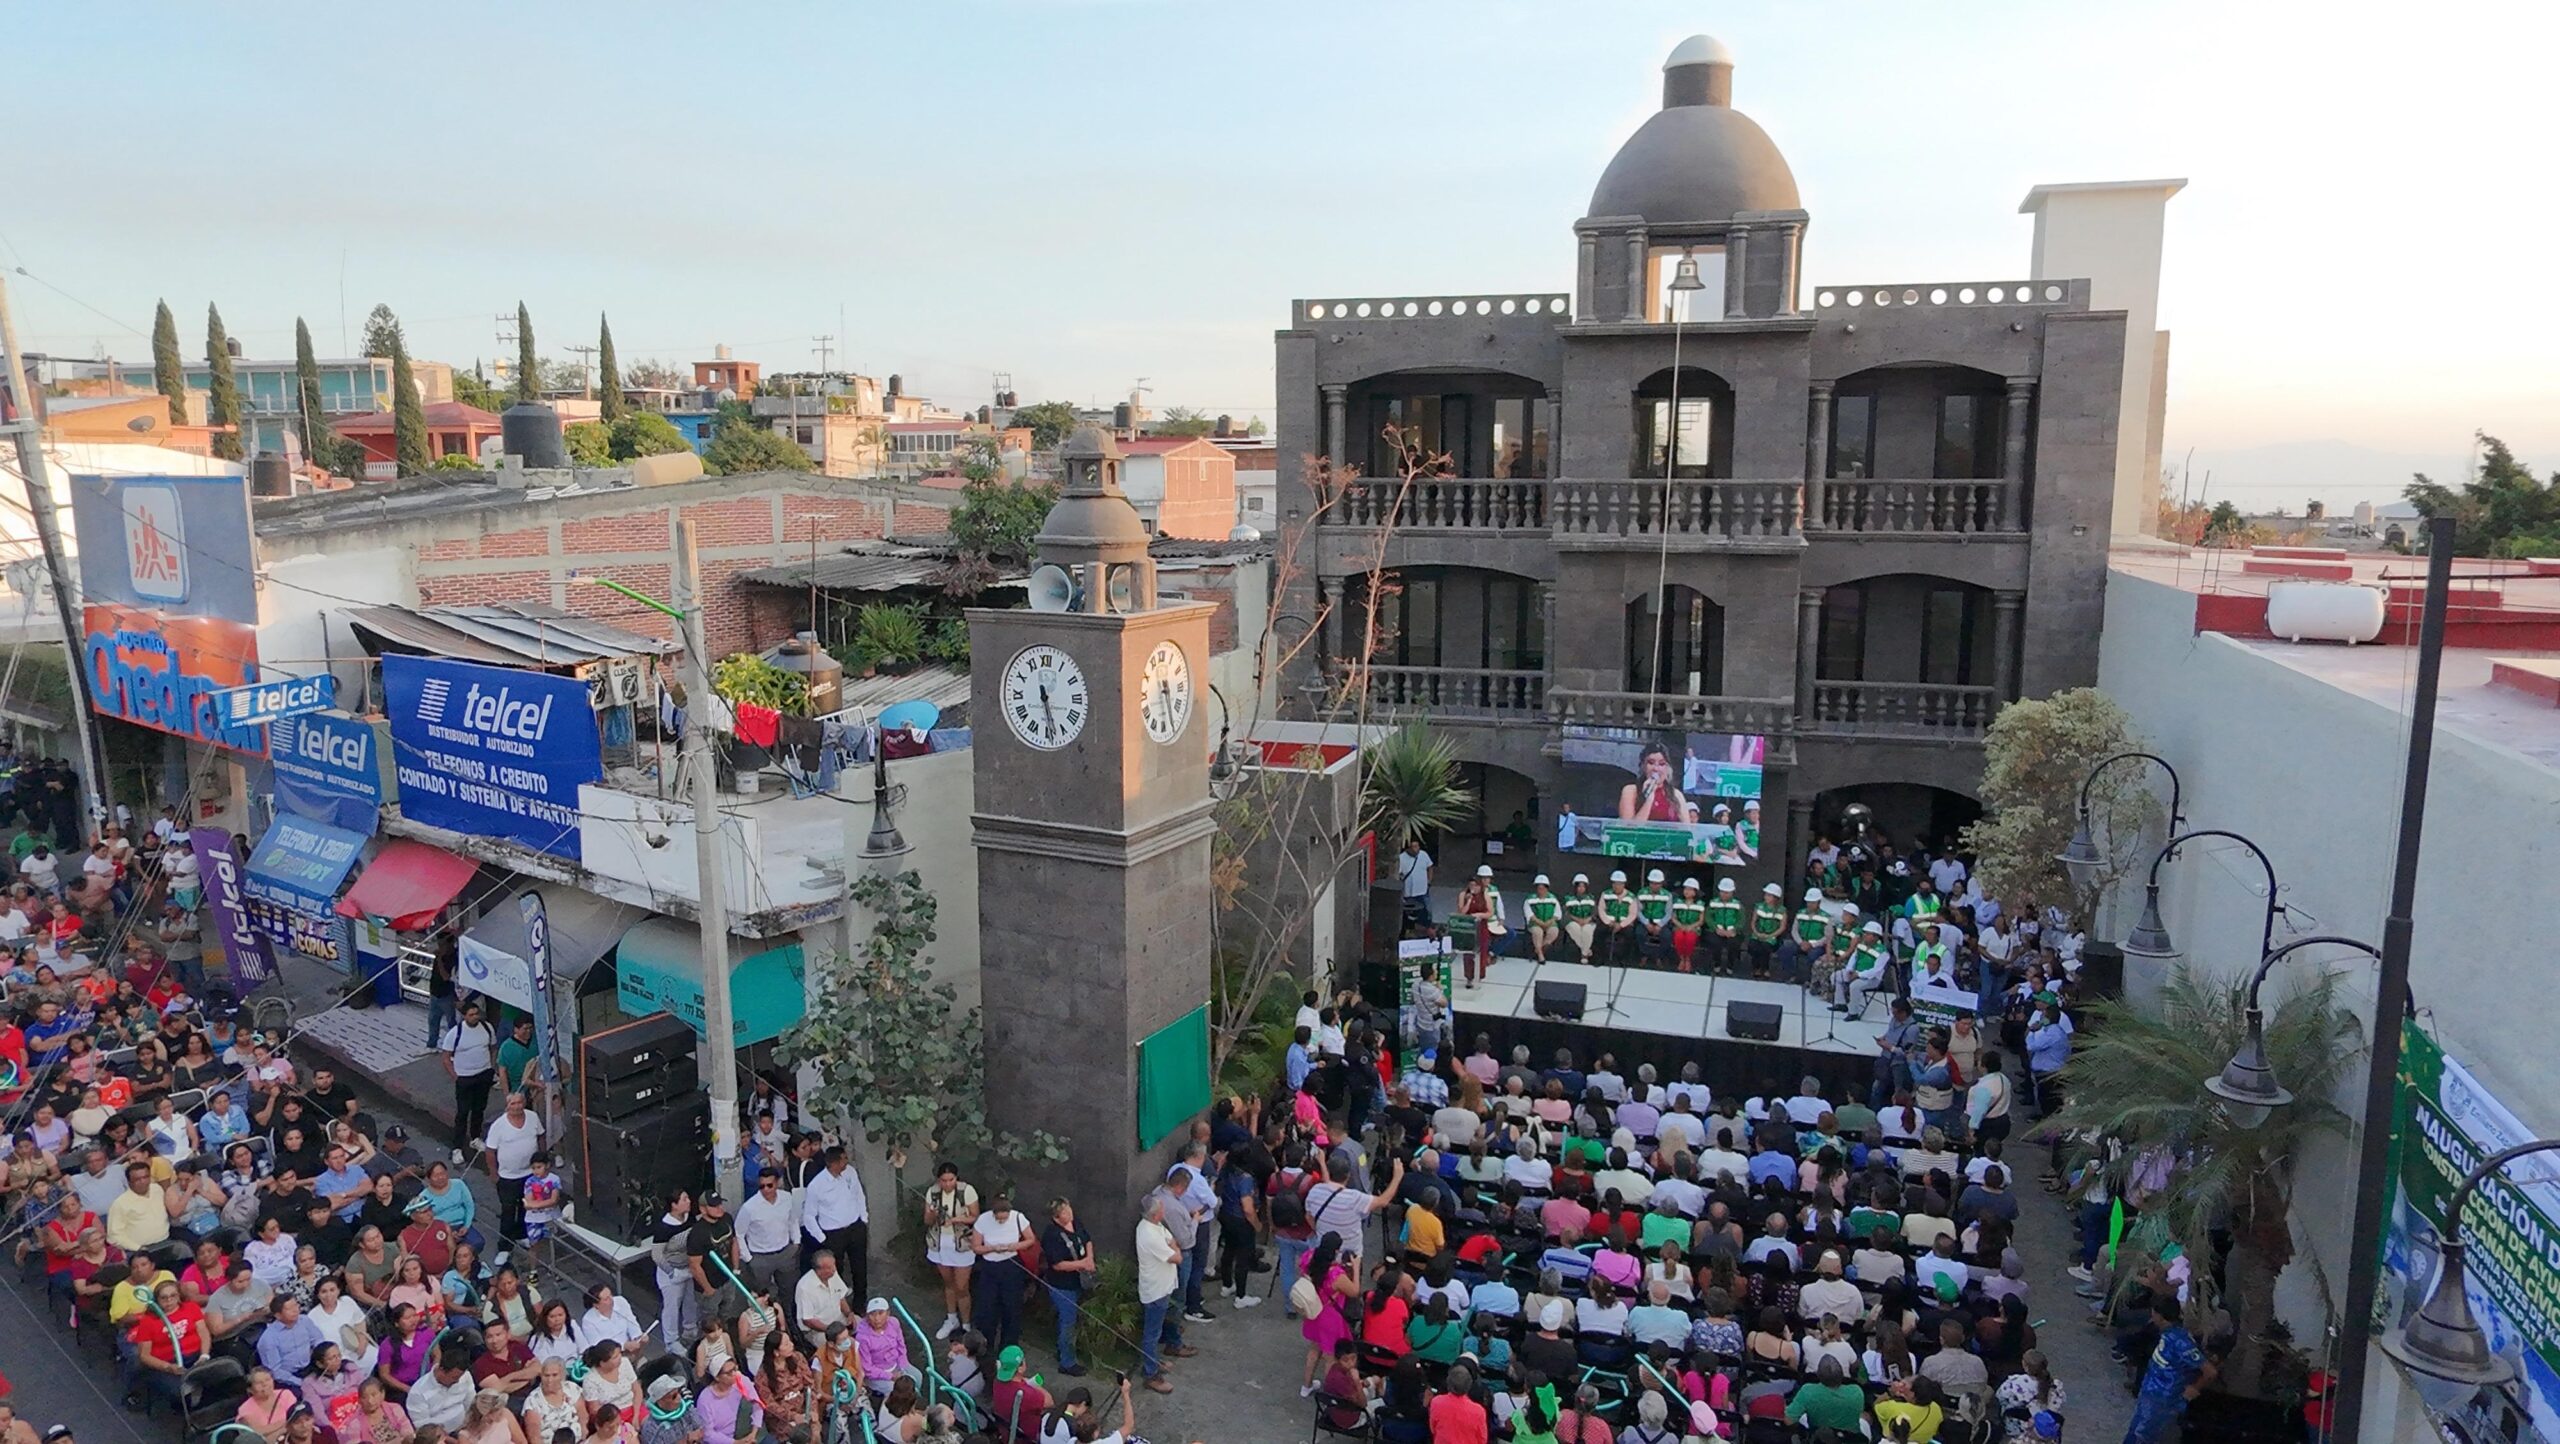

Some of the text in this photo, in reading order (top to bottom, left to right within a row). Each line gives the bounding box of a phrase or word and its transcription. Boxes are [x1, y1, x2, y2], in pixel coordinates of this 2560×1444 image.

[257, 678, 320, 713] telcel
[464, 683, 553, 741] telcel
[298, 719, 367, 771] telcel
[428, 724, 534, 758] DISTRIBUIDOR AUTORIZADO
[399, 766, 447, 796] CONTADO
[449, 779, 457, 799] Y
[460, 785, 507, 812] SISTEMA
[511, 796, 525, 816] DE
[425, 750, 548, 795] TELEFONOS A CREDITO
[208, 849, 254, 945] telcel
[1914, 1009, 1957, 1021] INAUGURA
[2422, 1136, 2507, 1240] CONSTRCCIÓN
[2508, 1231, 2529, 1262] DE
[2460, 1204, 2522, 1286] PLANADA
[2458, 1224, 2501, 1279] COLONIA
[2502, 1272, 2529, 1309] TRES
[2529, 1303, 2546, 1329] DE
[2464, 1250, 2544, 1350] MILIANO ZAPATA
